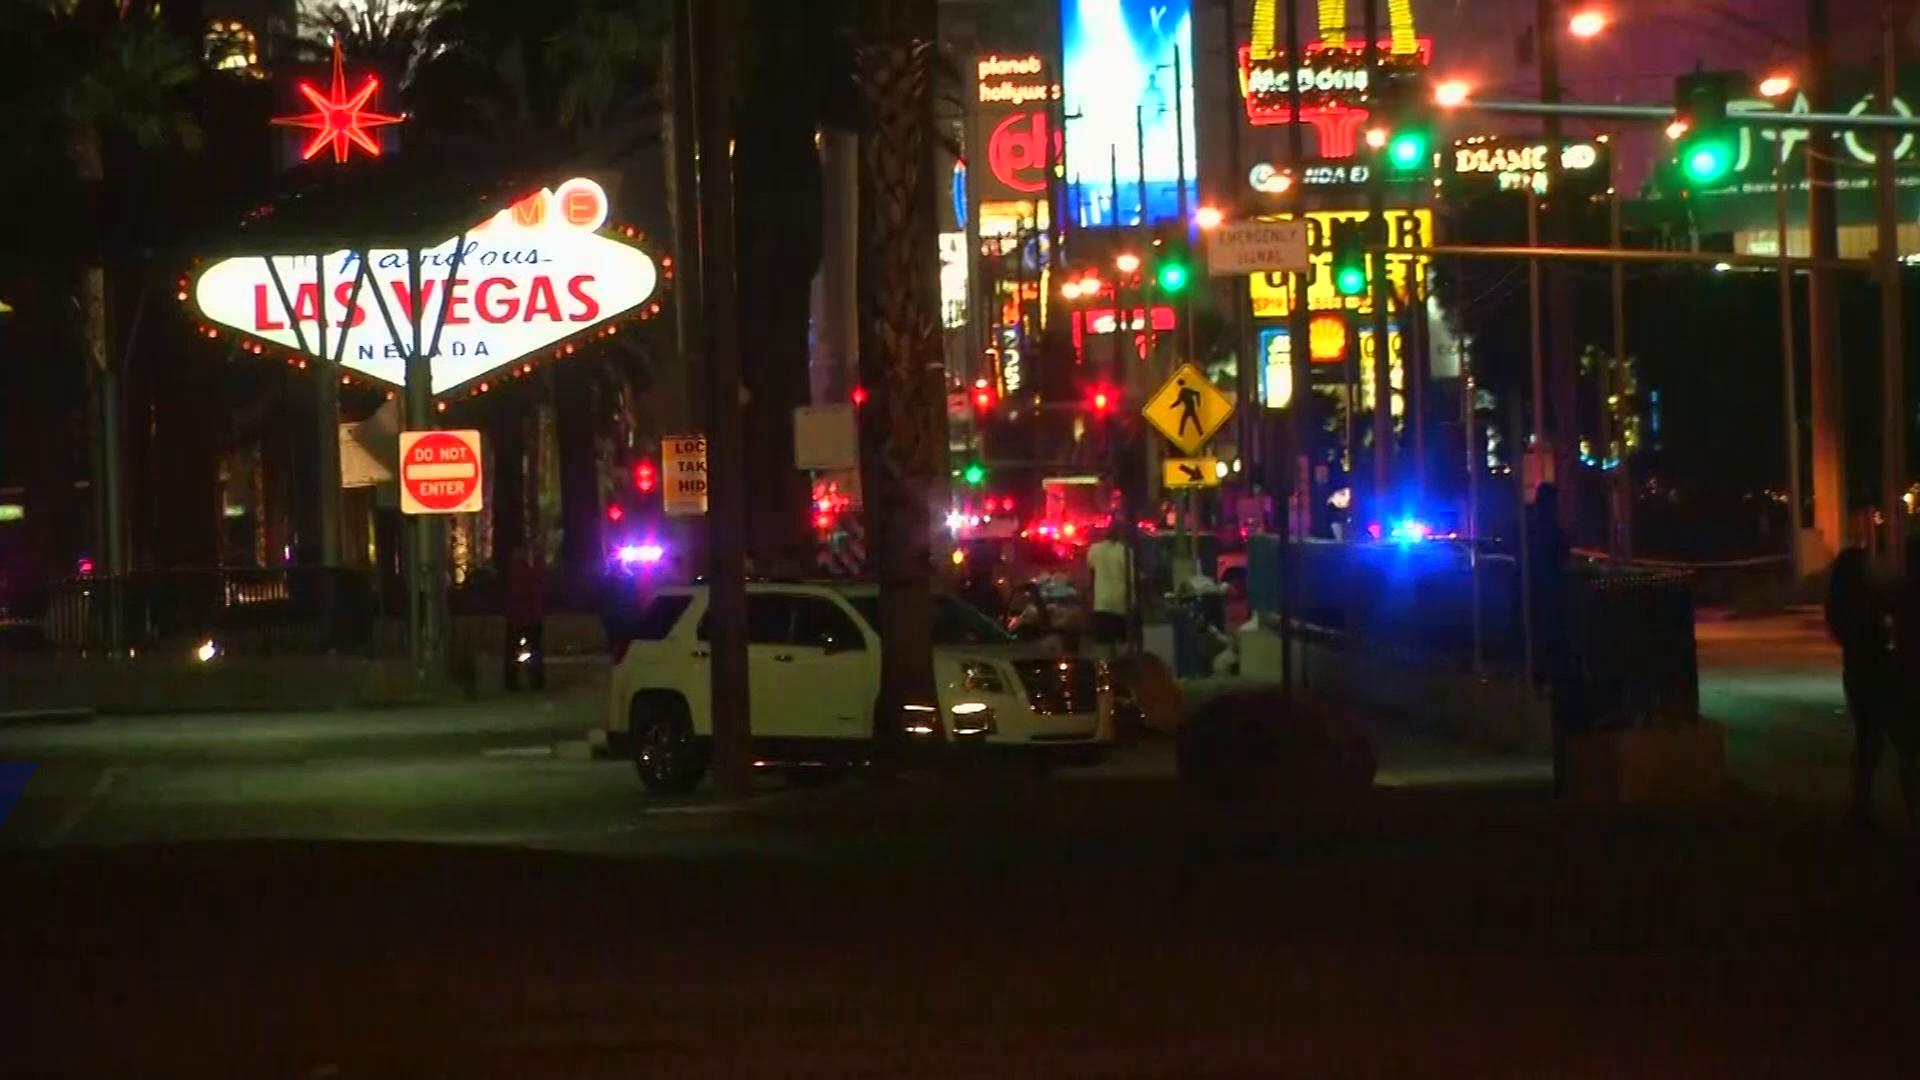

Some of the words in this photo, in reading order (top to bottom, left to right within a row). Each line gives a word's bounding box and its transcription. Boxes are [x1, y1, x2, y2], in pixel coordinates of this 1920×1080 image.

[979, 55, 1041, 80] planet
[254, 282, 366, 332] LAS
[390, 274, 600, 326] VEGAS
[415, 448, 434, 463] DO
[440, 446, 467, 461] NOT
[676, 441, 706, 454] LOC
[420, 481, 464, 497] ENTER
